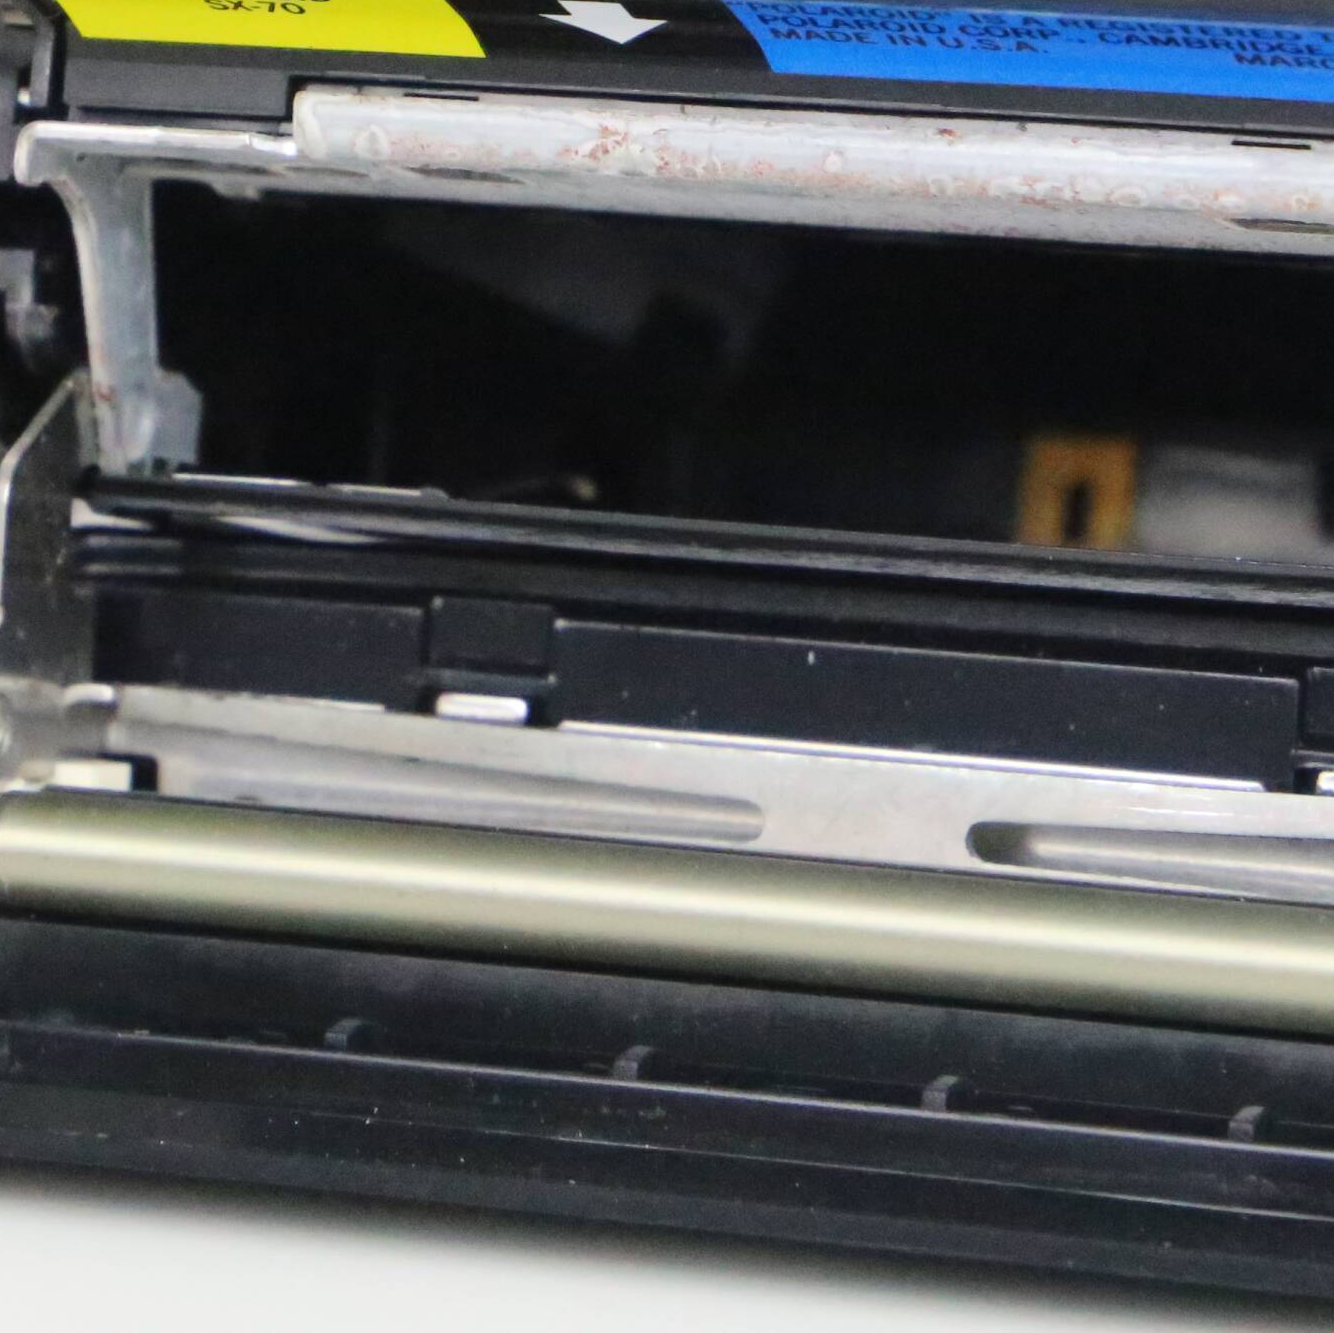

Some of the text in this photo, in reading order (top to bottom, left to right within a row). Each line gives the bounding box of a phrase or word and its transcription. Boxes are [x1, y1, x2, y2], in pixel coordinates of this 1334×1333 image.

[756, 13, 947, 35] POLAROID
[968, 13, 1007, 25] IS
[1021, 16, 1046, 27] A
[1056, 18, 1303, 41] REGISTERED
[768, 27, 1049, 54] MADE IN U.S.A.
